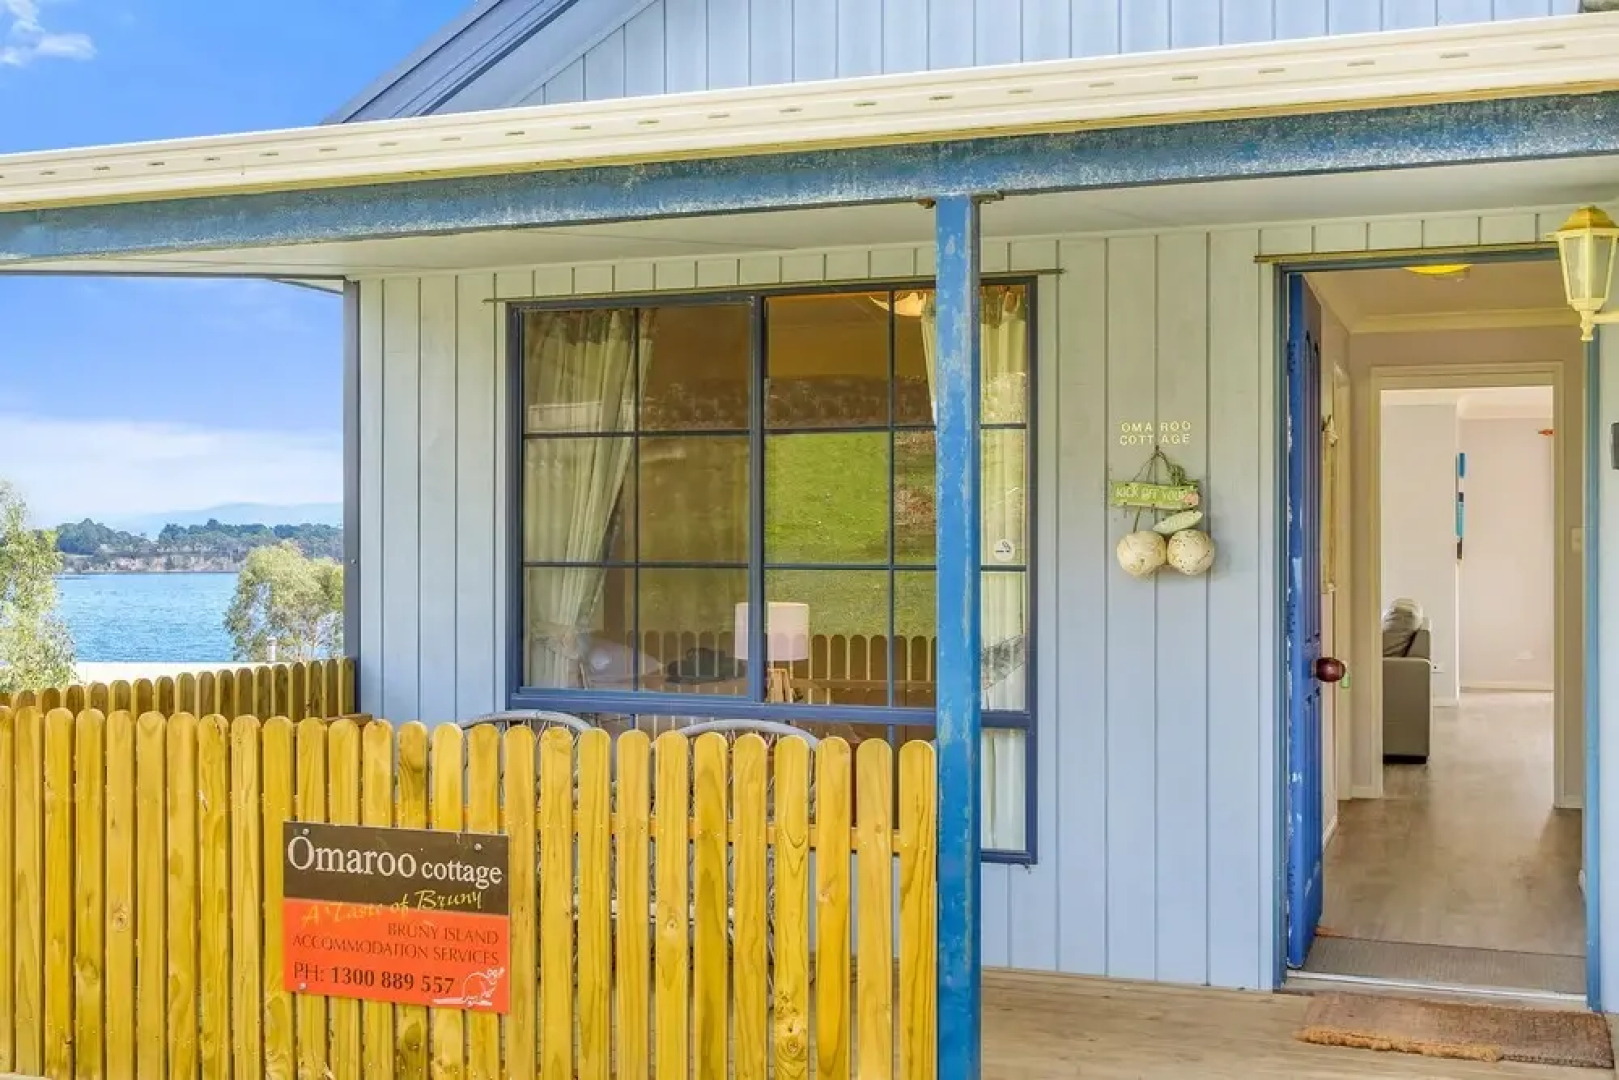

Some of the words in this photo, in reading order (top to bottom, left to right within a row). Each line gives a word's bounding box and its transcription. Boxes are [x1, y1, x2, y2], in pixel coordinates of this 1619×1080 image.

[1119, 433, 1191, 446] COTTAGE
[287, 836, 417, 878] Omaroo
[421, 861, 503, 890] cottage
[302, 904, 319, 925] A
[389, 893, 409, 915] of
[414, 889, 482, 911] Bruny
[292, 934, 429, 960] ACCOMMODATION
[433, 947, 500, 966] SERVICES
[388, 922, 440, 940] BRUNY
[444, 927, 499, 945] ISLAND
[293, 961, 325, 982] PH:
[331, 966, 375, 987] 1300
[381, 970, 414, 991] 889
[420, 976, 455, 995] 557
